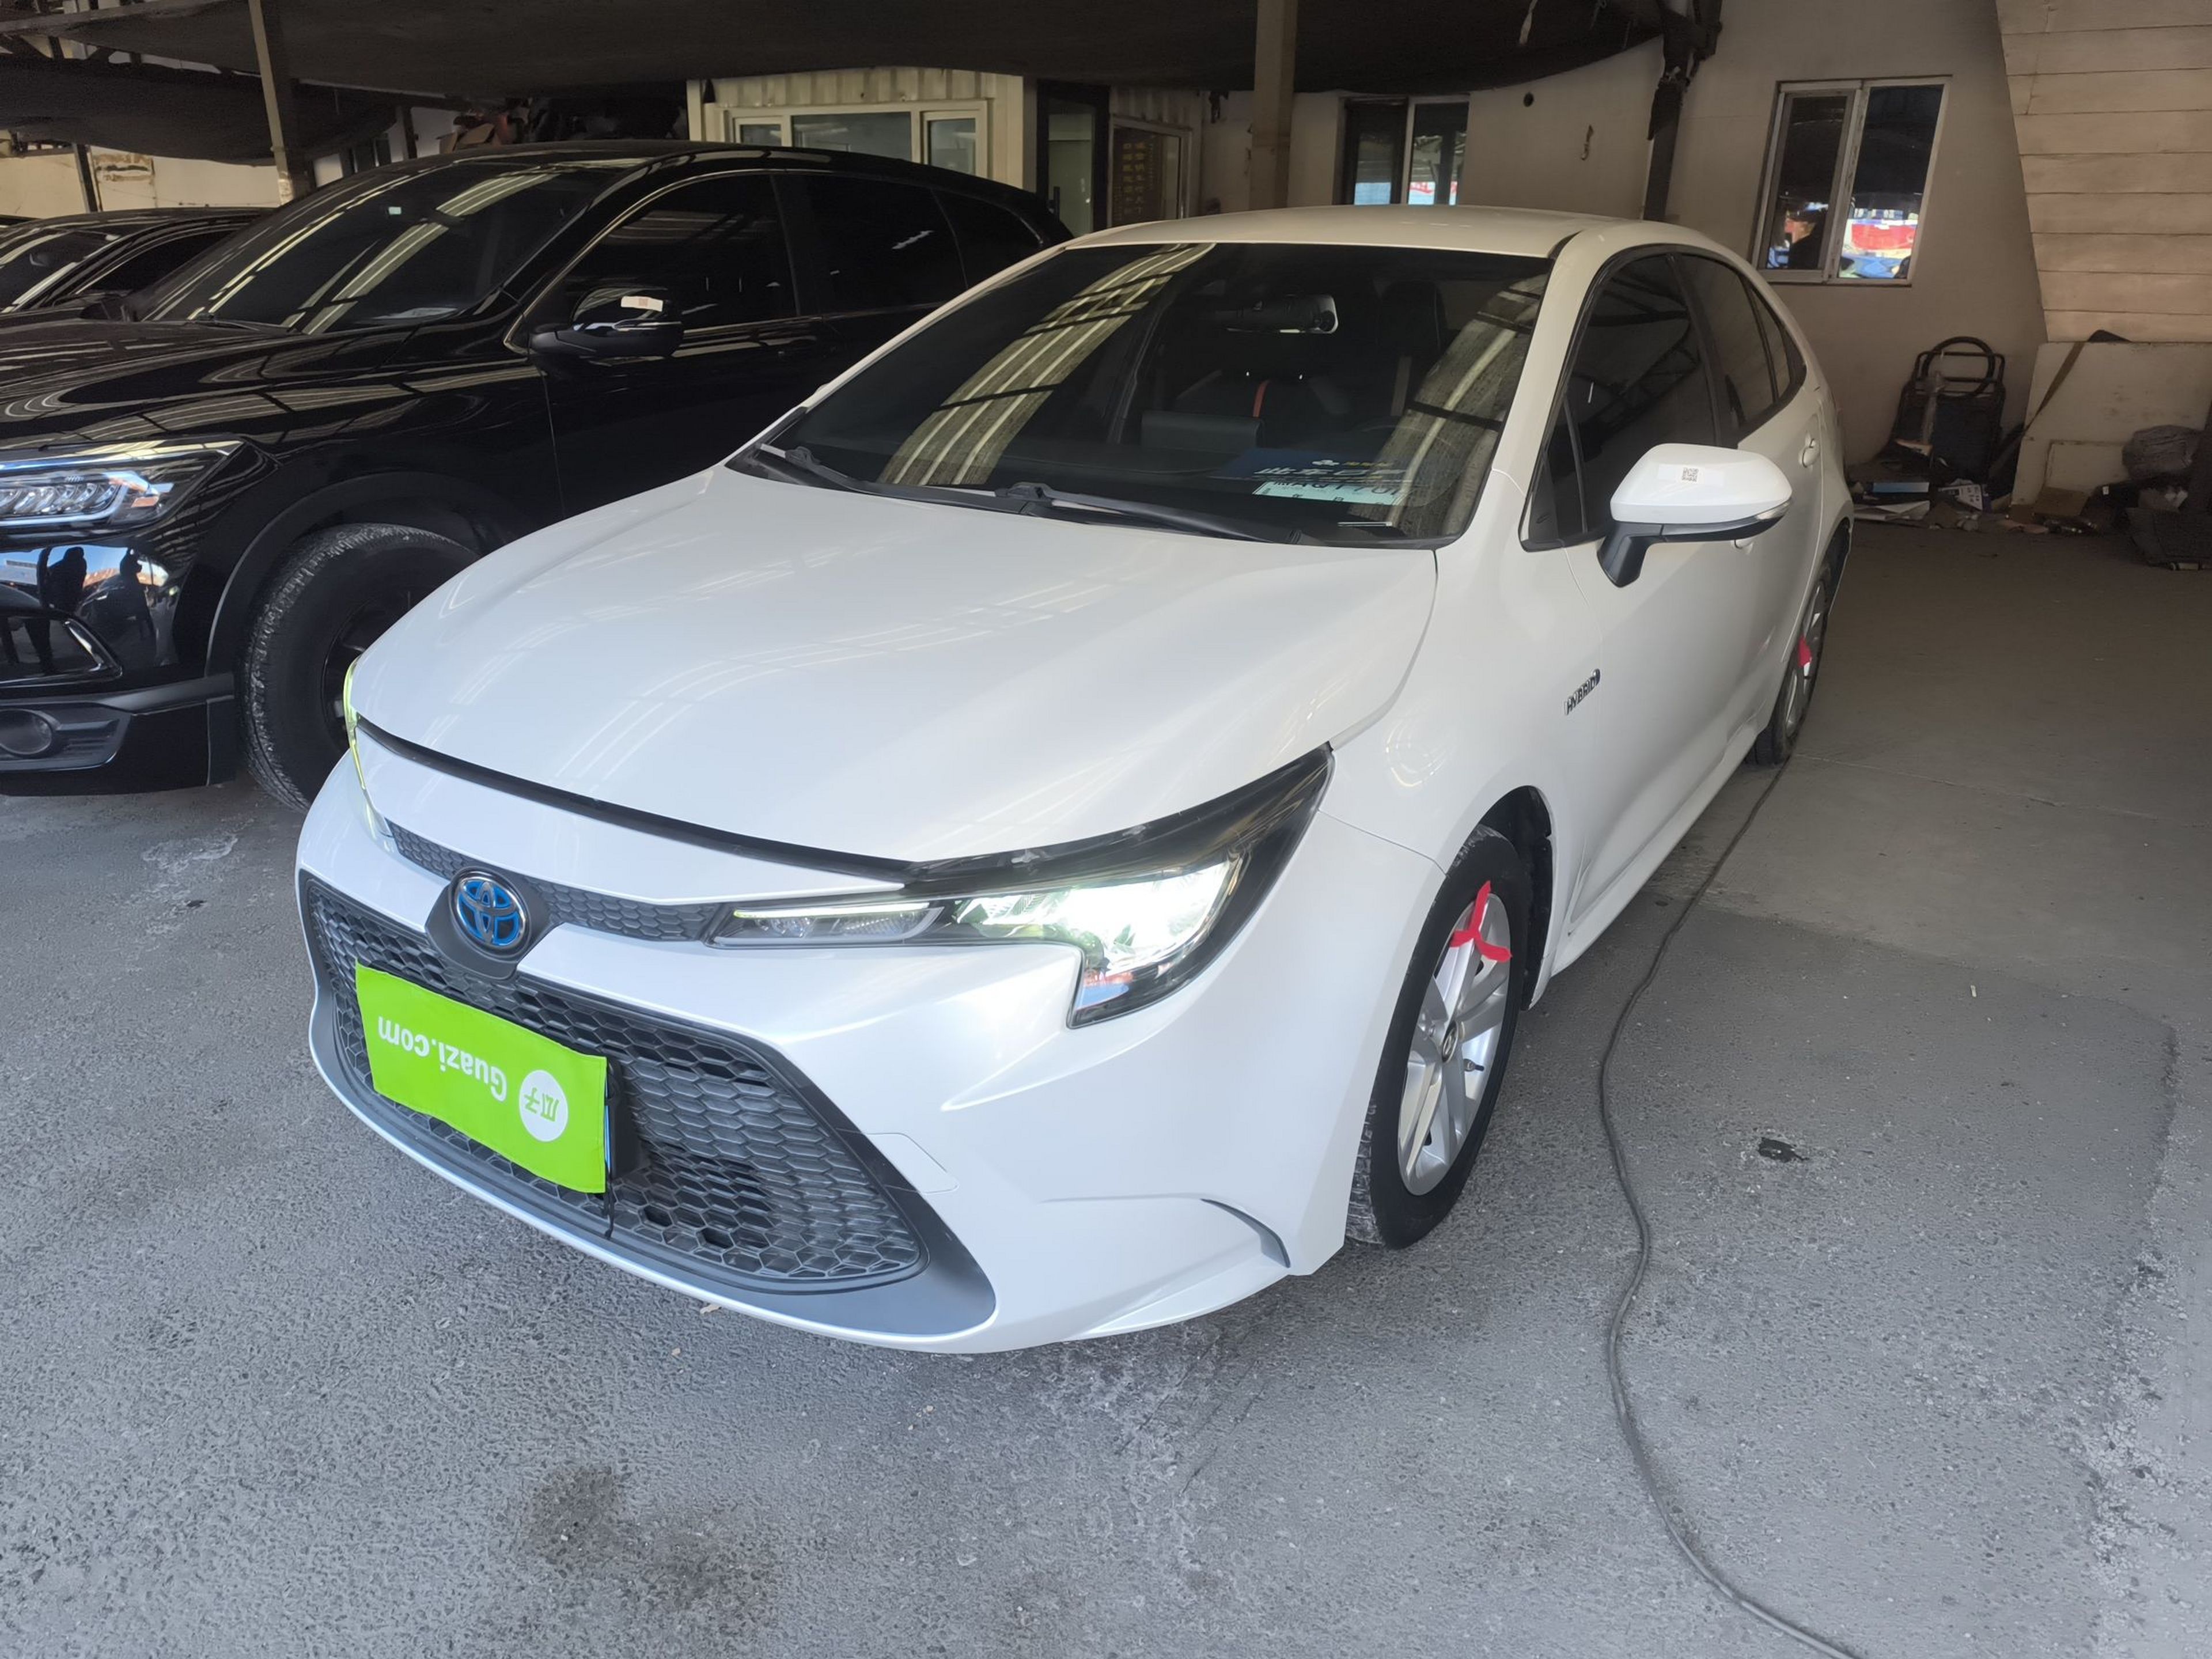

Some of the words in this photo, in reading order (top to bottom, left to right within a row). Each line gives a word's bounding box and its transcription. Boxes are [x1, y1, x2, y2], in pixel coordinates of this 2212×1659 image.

[1566, 675, 1596, 715] HYBRID
[378, 1016, 507, 1103] Guazi.com
[524, 1088, 559, 1122] 瓜子
